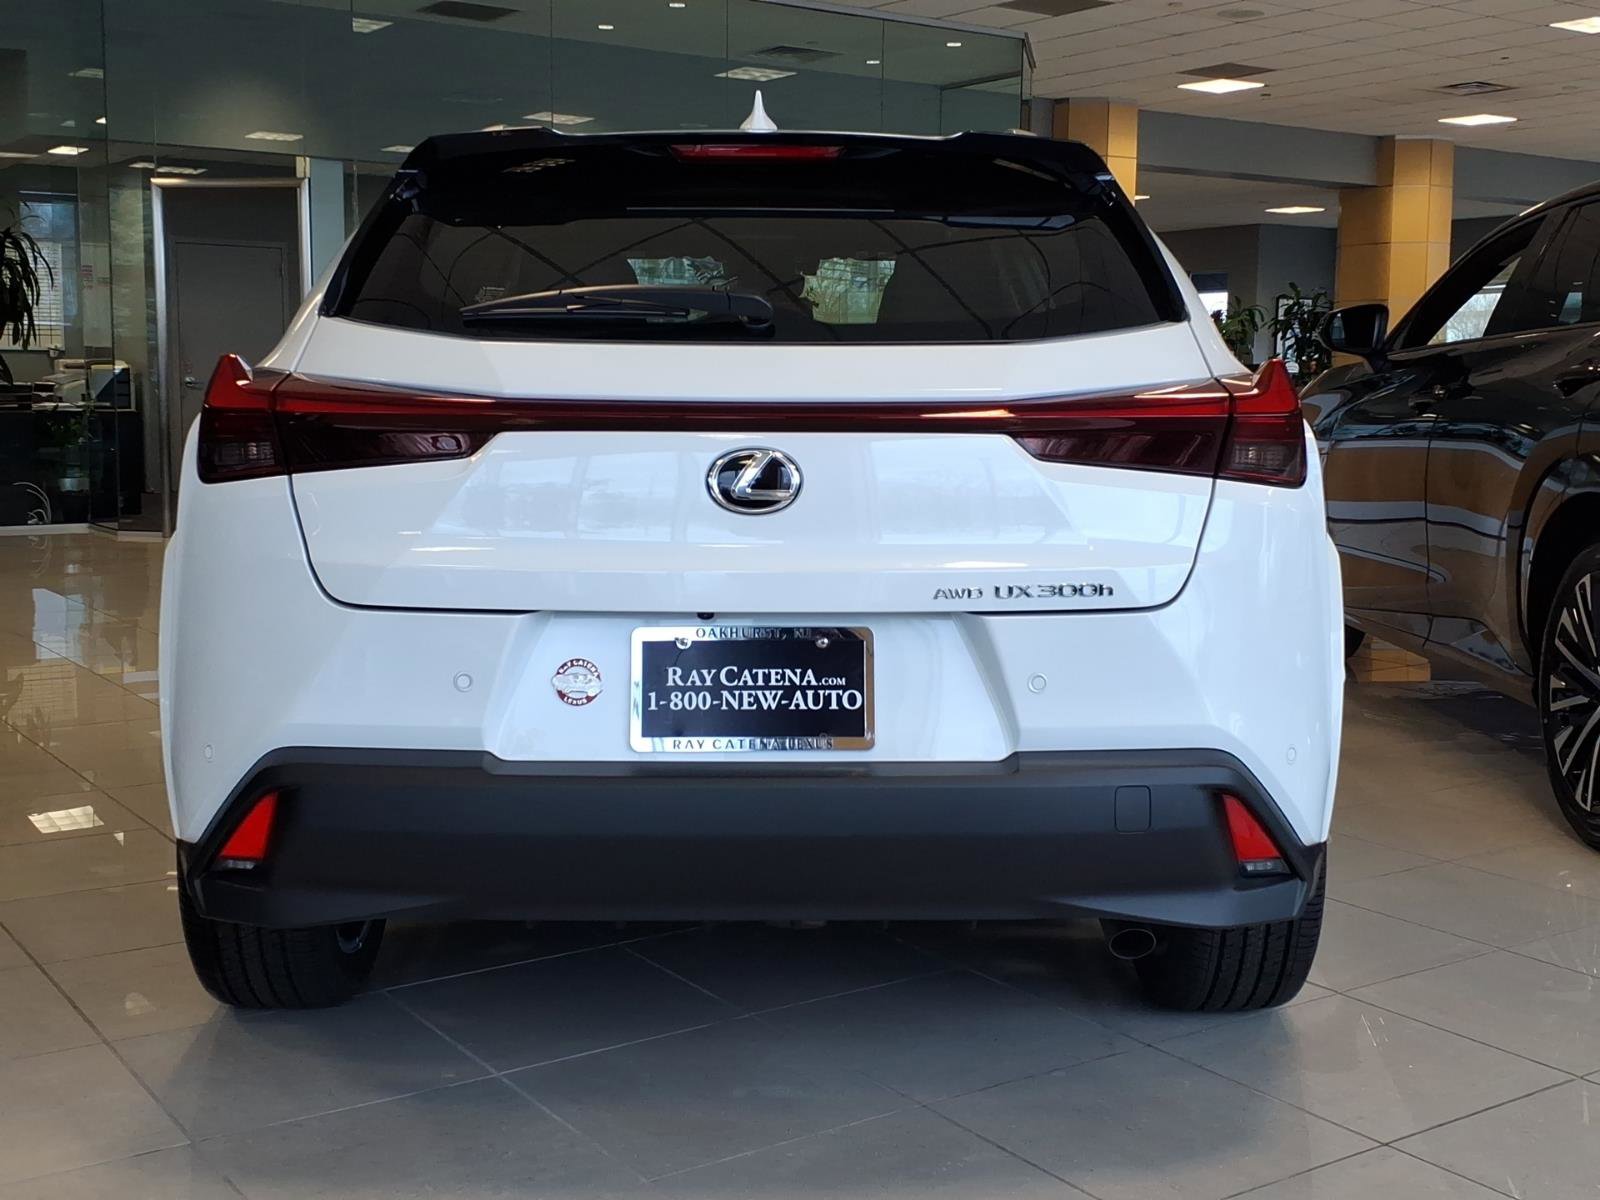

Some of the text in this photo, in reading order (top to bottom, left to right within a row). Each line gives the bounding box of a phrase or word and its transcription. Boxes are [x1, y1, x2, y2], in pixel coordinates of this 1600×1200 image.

[933, 582, 1114, 600] AWD UX 300h
[648, 690, 863, 711] 1-800-NEW-AUTO
[673, 739, 705, 750] RAY
